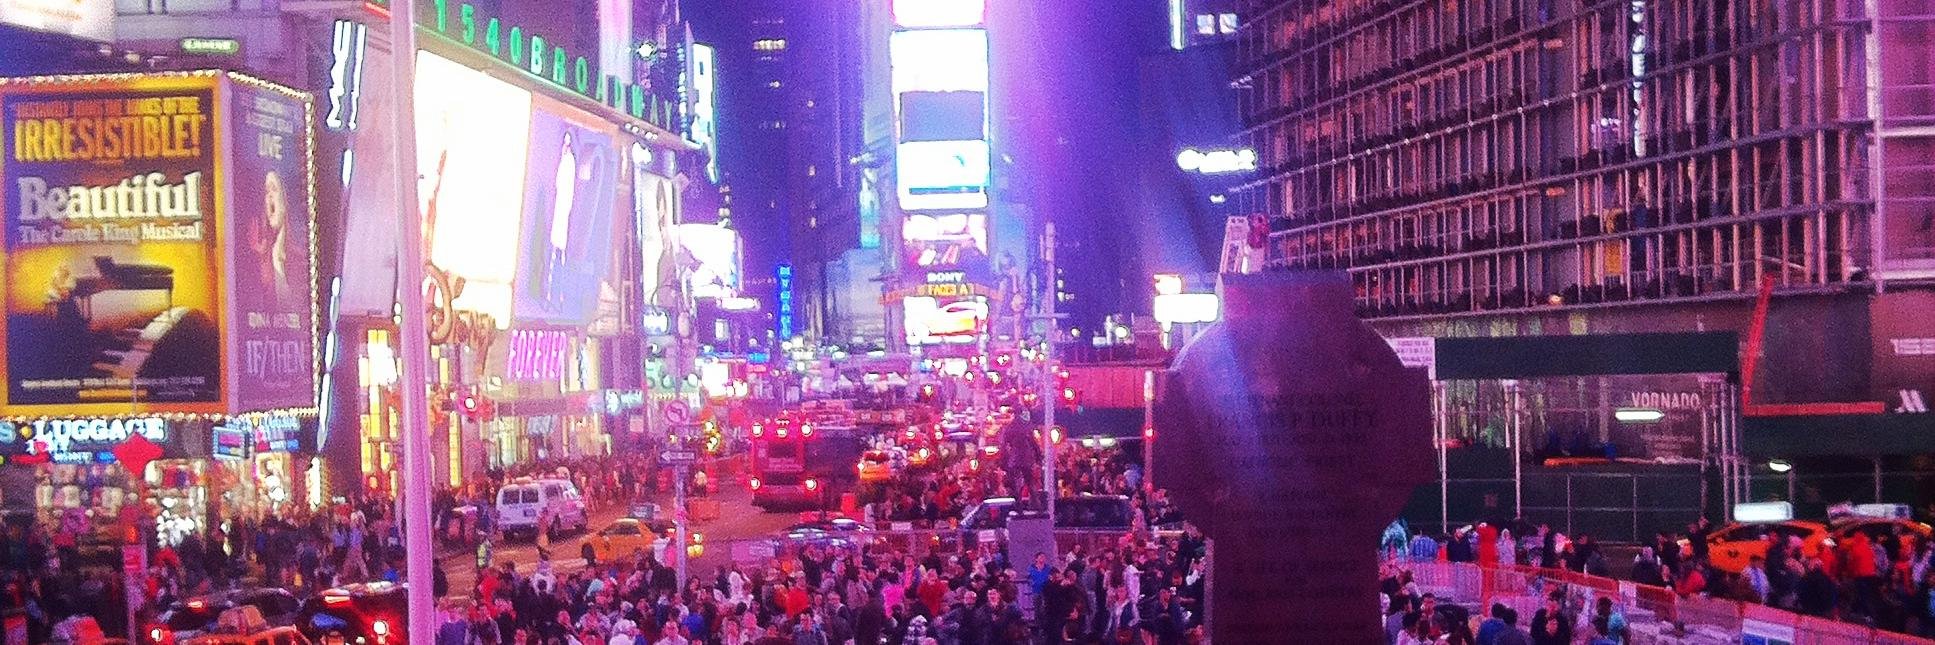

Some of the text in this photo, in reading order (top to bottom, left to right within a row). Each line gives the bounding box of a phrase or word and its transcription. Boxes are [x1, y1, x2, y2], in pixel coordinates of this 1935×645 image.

[14, 114, 206, 161] IRRESISTIBLE!
[17, 171, 202, 220] Beautiful
[140, 221, 203, 241] Musical
[927, 272, 965, 283] SONY
[507, 329, 569, 379] FOREVER
[1631, 391, 1701, 409] VORNADO
[34, 418, 166, 441] LUGGAGE
